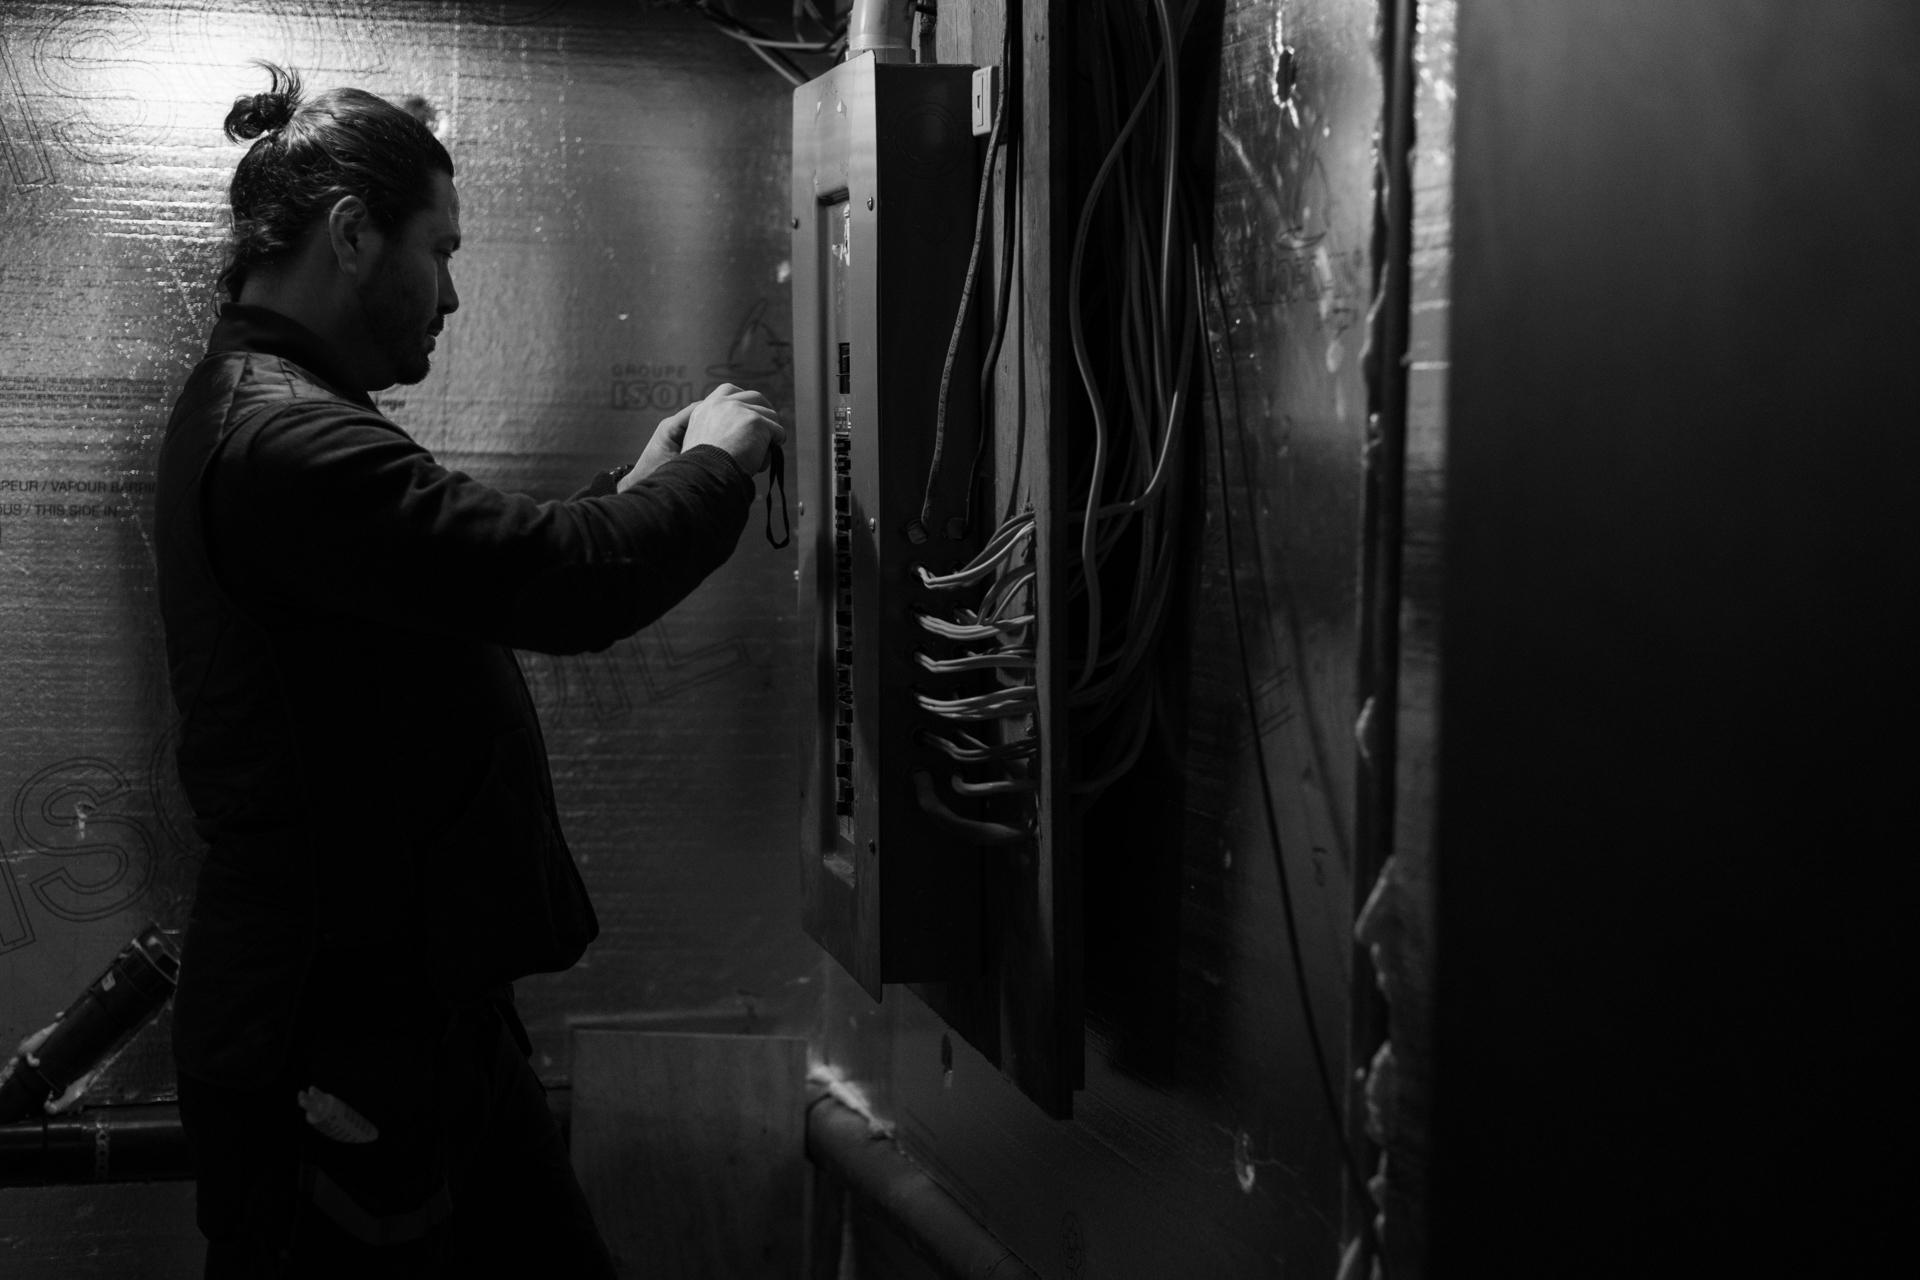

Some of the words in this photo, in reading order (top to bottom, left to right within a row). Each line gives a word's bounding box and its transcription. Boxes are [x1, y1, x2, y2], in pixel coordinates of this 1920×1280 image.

[610, 363, 687, 378] GROUPE
[0, 480, 38, 492] PEUR
[50, 480, 106, 493] VAPOUR
[34, 504, 65, 517] THIS
[68, 504, 99, 518] SIDE
[103, 505, 118, 518] IN
